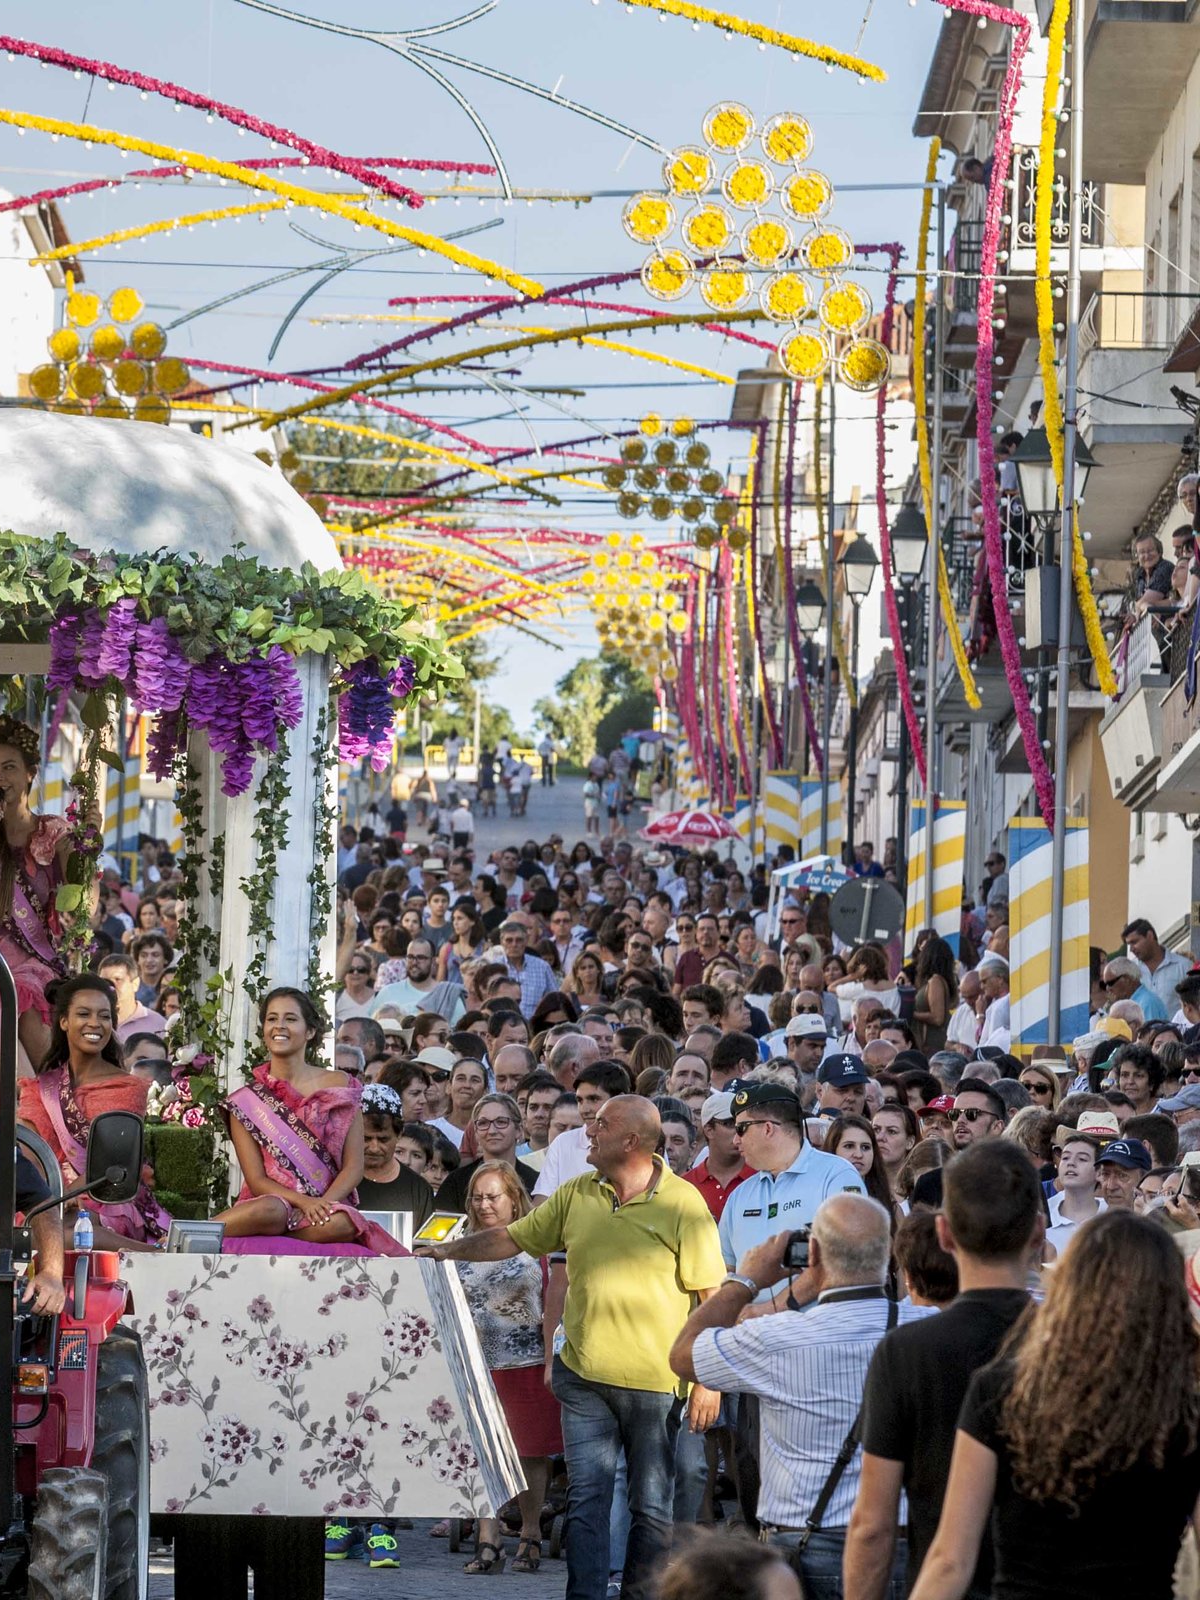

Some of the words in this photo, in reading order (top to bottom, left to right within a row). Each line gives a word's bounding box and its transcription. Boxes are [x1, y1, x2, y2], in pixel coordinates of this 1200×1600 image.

[806, 873, 819, 884] Ice
[821, 874, 846, 888] Crea
[258, 1110, 279, 1136] Dama
[288, 1143, 313, 1171] Honor
[783, 1200, 802, 1211] GNR
